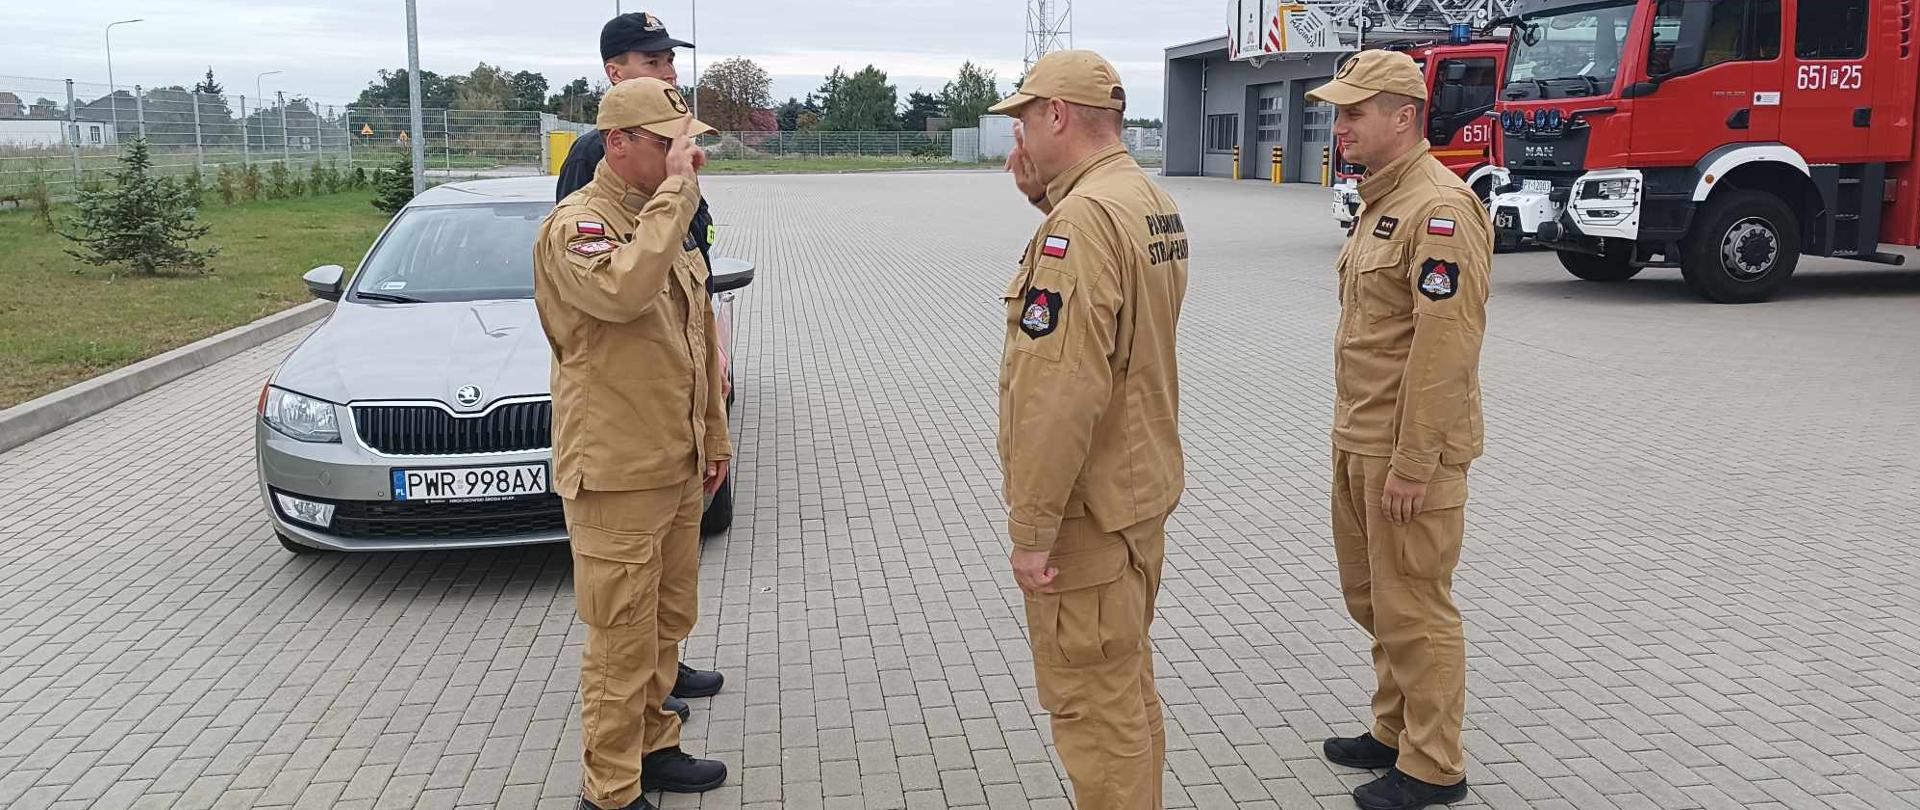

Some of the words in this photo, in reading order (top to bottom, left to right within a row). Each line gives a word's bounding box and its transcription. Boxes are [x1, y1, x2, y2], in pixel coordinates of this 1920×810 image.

[1290, 19, 1316, 47] MAGIRUS
[1525, 146, 1554, 157] MAN
[407, 472, 457, 497] PWR
[465, 467, 543, 495] 998AX
